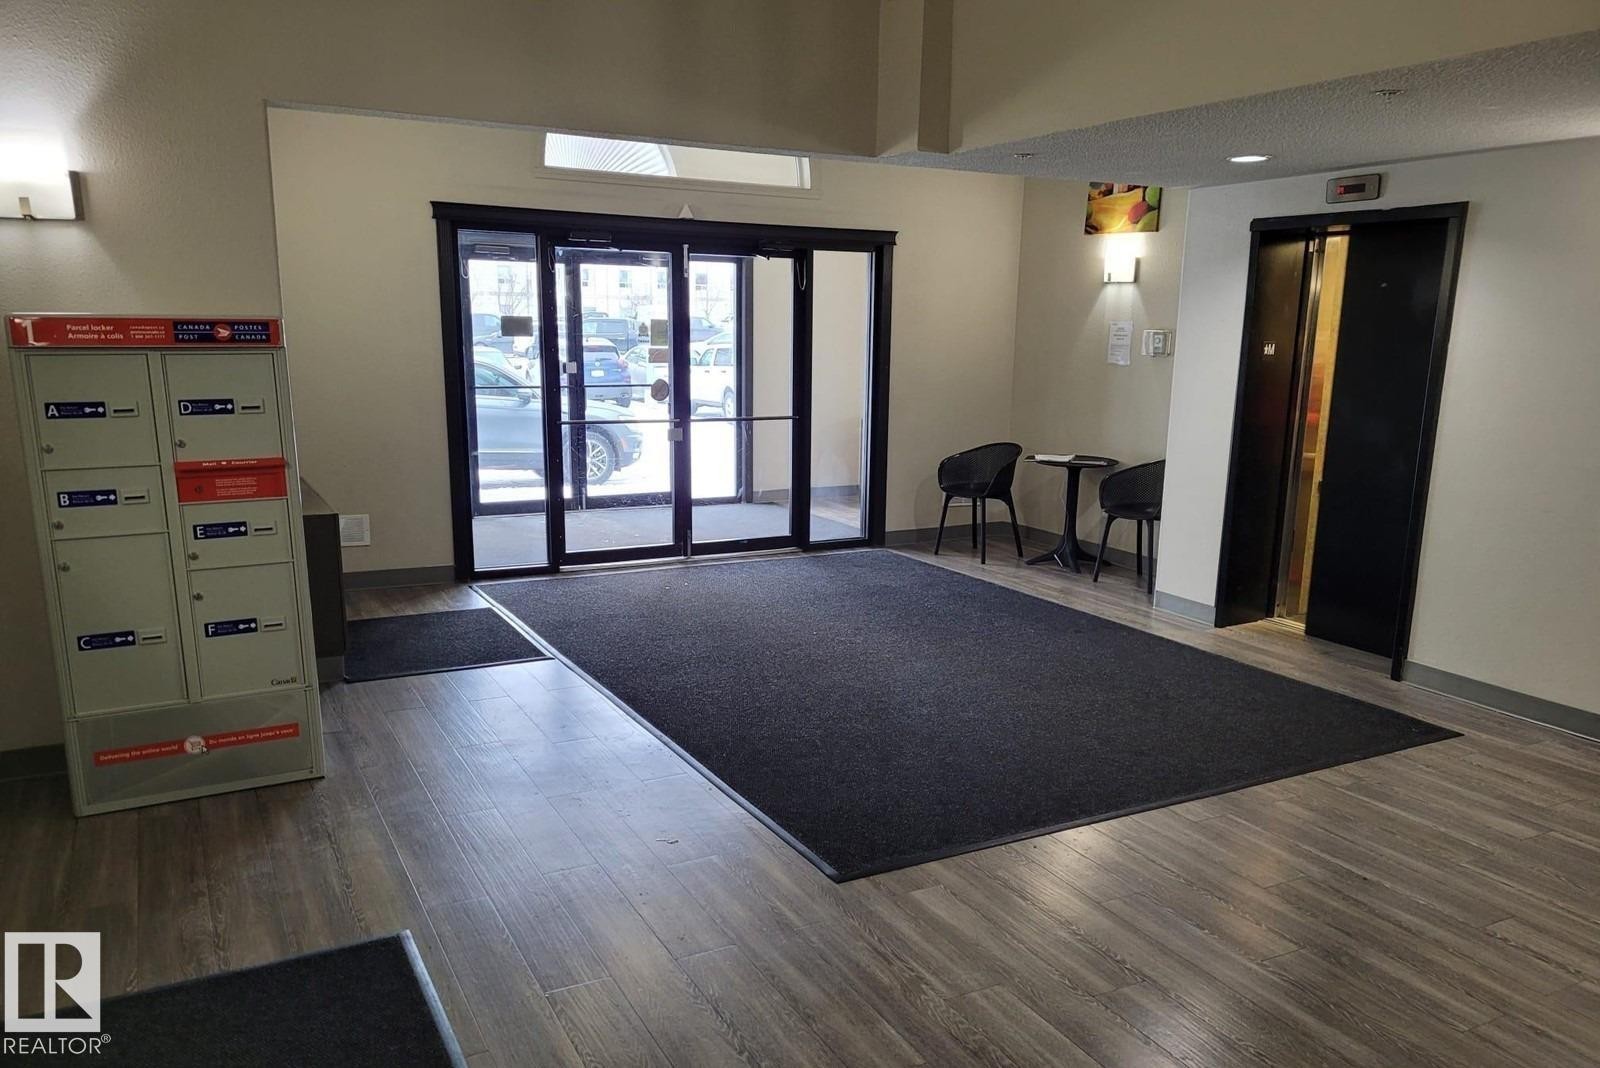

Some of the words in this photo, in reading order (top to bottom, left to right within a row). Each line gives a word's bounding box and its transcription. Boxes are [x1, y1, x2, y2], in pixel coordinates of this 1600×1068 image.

[47, 406, 59, 417] A
[180, 402, 192, 414] D
[60, 494, 70, 506] B
[196, 526, 205, 538] E
[208, 624, 215, 636] F
[80, 637, 91, 649] C
